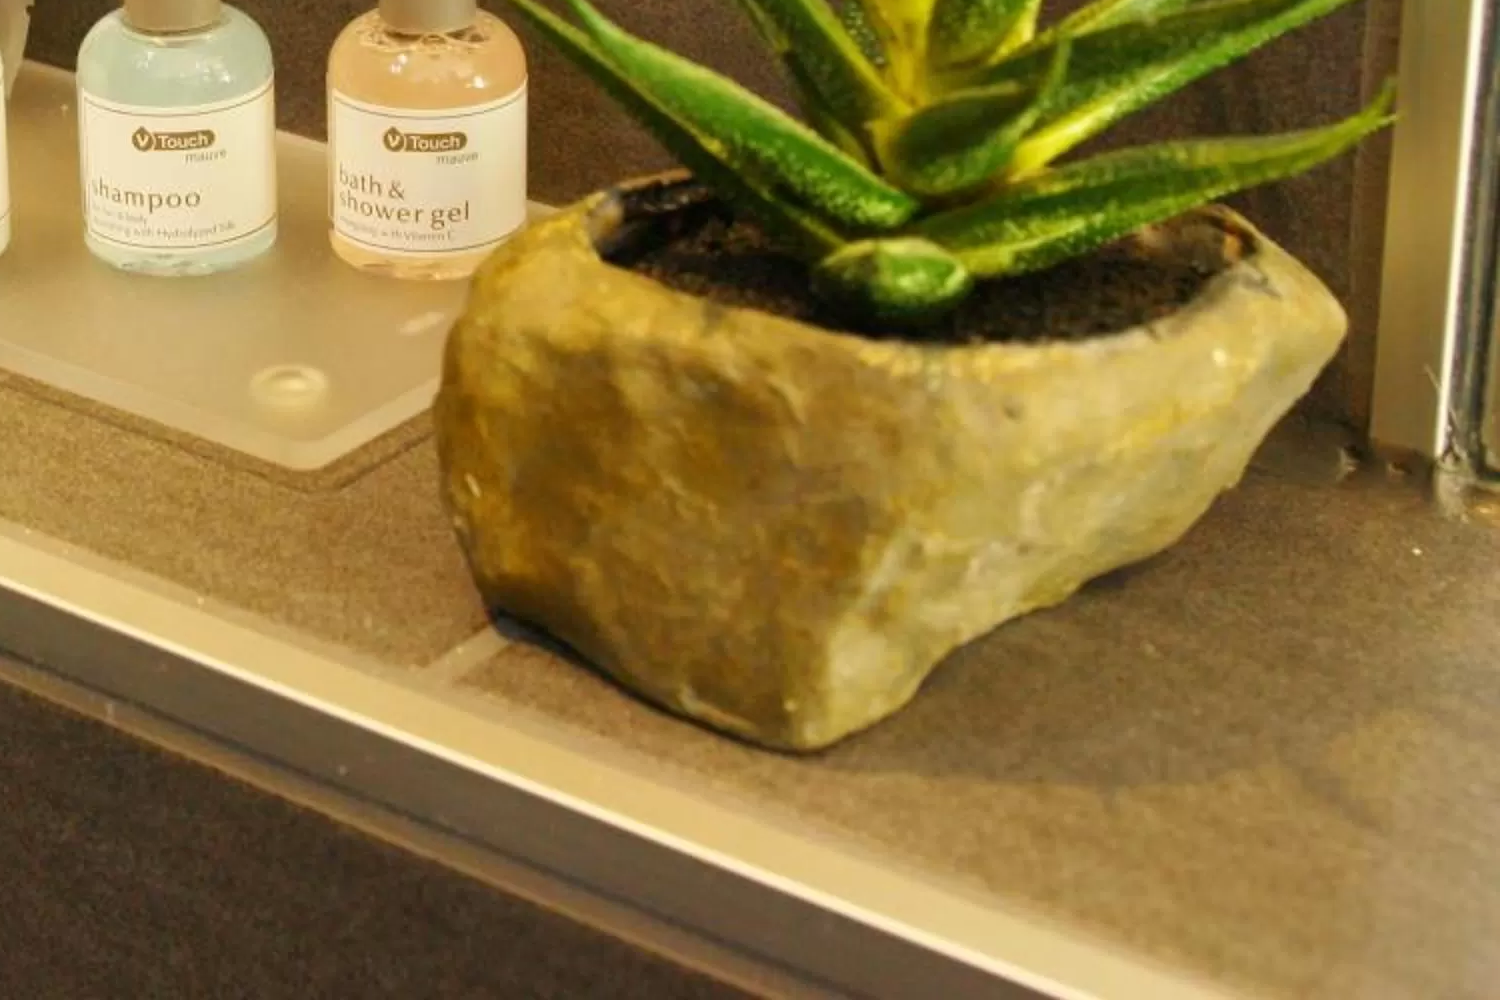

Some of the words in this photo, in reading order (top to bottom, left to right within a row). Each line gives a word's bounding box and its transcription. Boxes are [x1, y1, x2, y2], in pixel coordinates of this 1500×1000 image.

[134, 131, 151, 149] V
[157, 132, 210, 149] Touch
[386, 131, 403, 149] V
[408, 133, 462, 150] Touch
[435, 151, 479, 165] mauve
[339, 160, 383, 197] bath
[388, 179, 405, 201] &
[91, 176, 202, 214] shampoo
[339, 189, 425, 224] shower
[430, 199, 470, 231] gel
